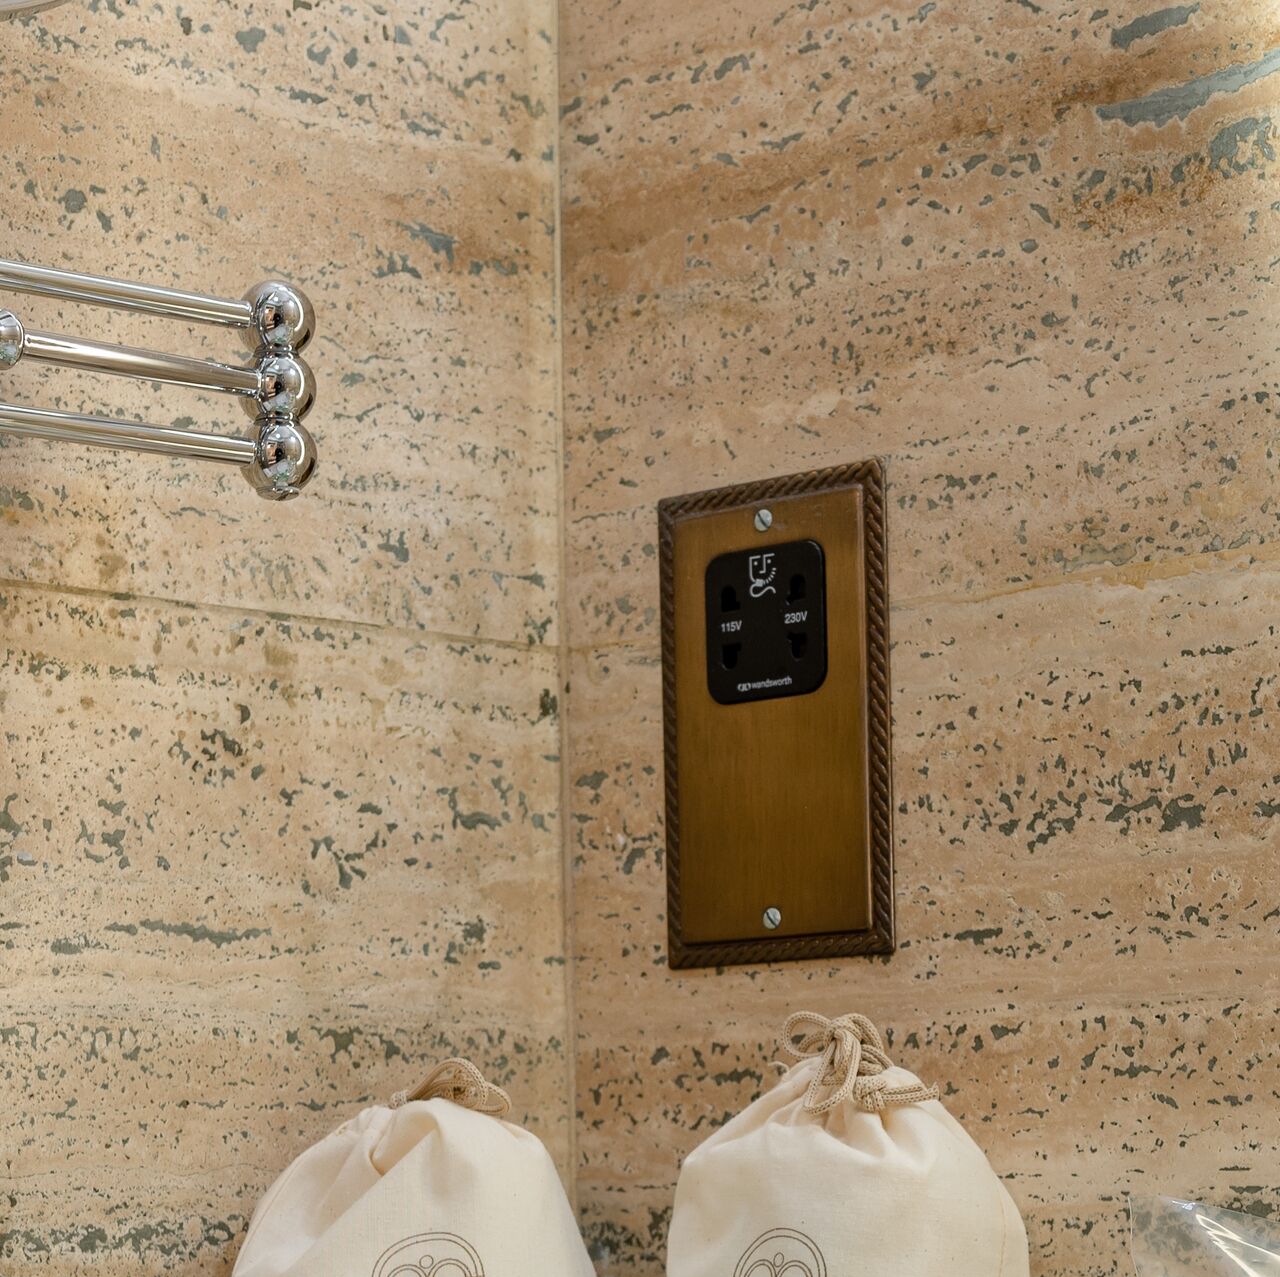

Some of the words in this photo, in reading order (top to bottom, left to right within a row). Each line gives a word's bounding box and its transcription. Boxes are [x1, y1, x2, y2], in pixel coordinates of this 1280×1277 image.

[721, 620, 742, 632] 115V
[784, 611, 808, 624] 230V
[751, 676, 793, 689] wandsworth
